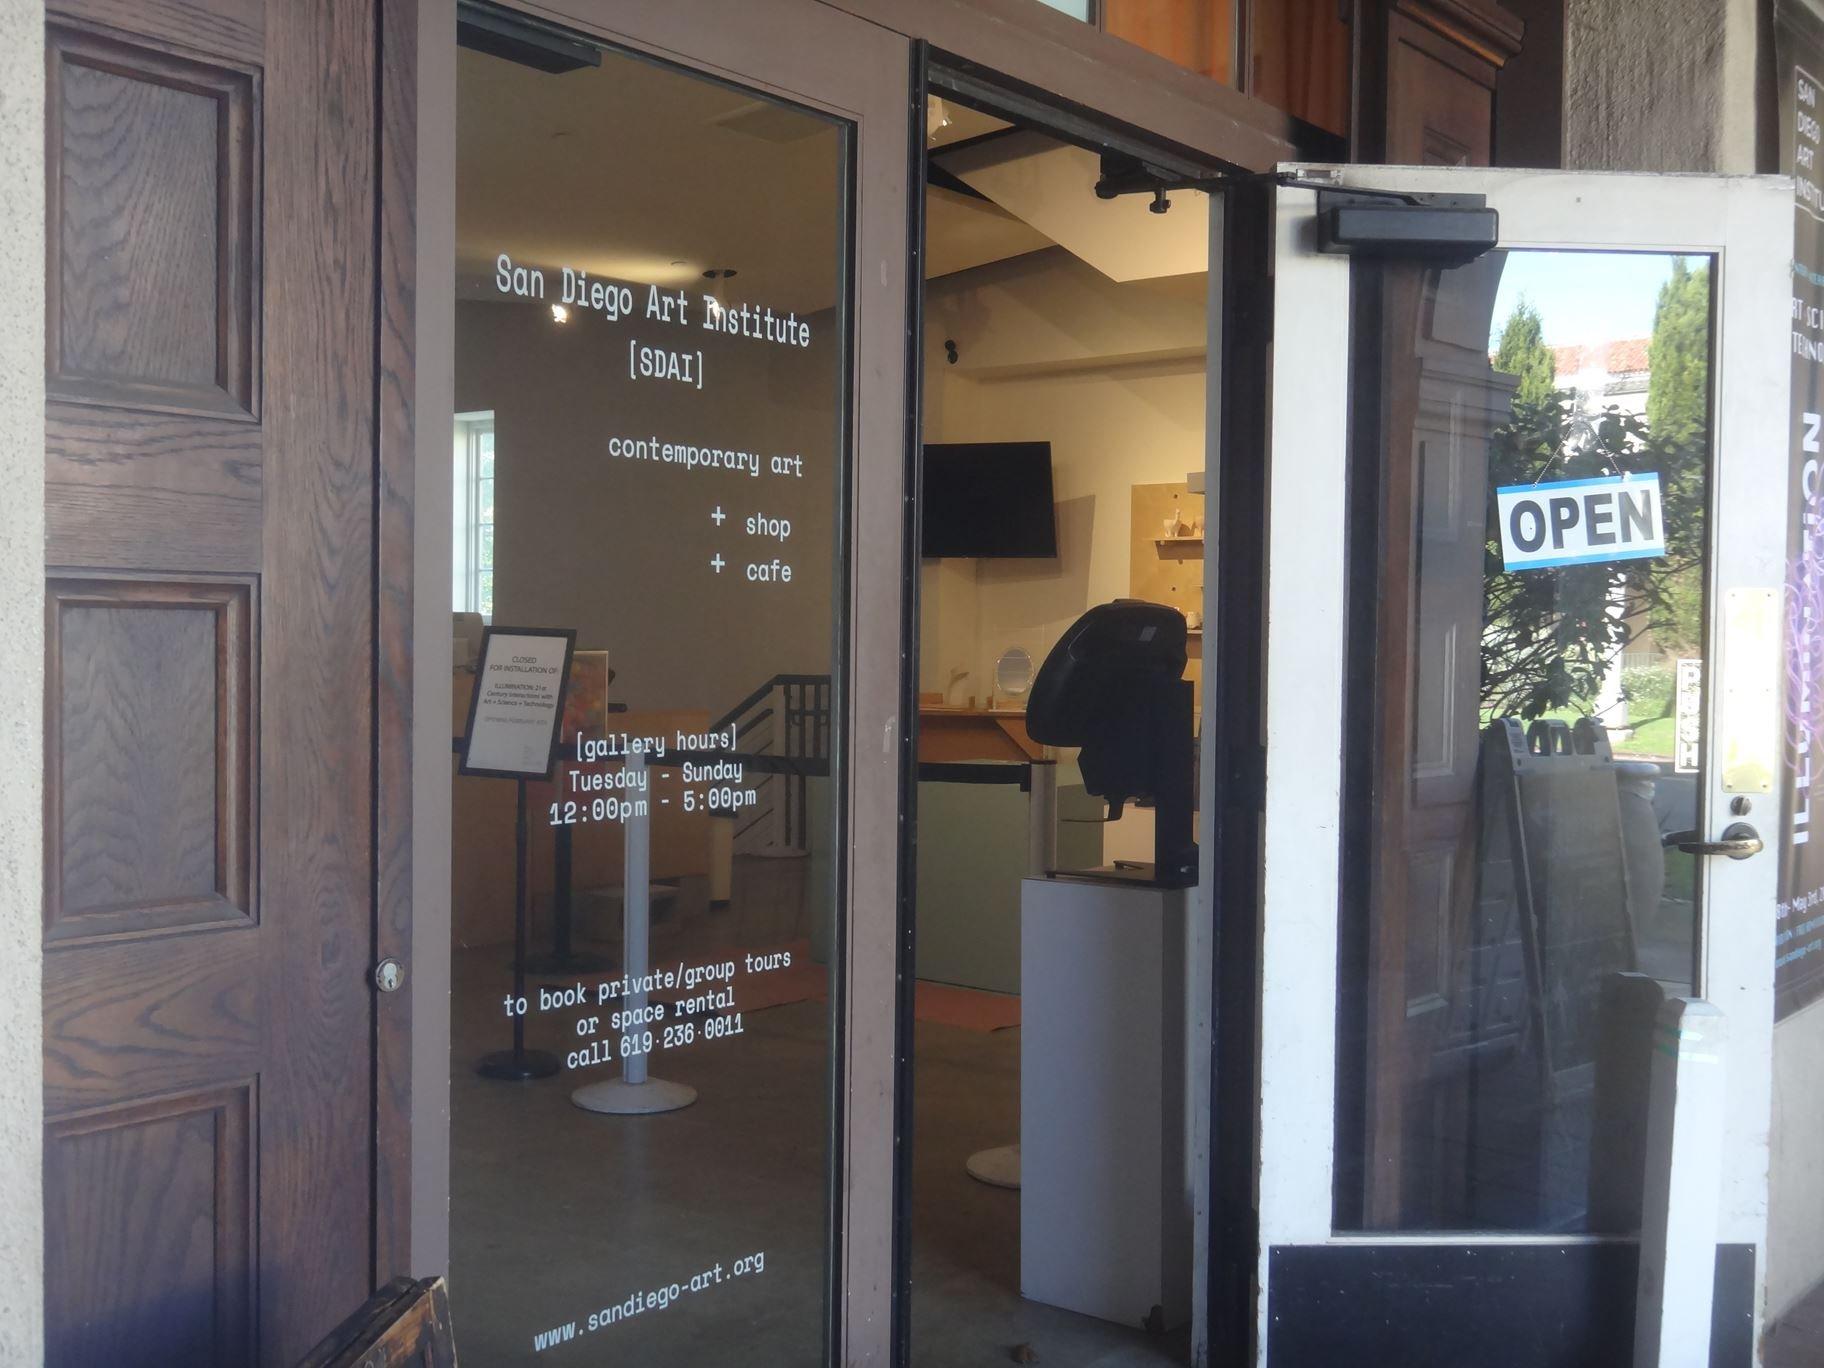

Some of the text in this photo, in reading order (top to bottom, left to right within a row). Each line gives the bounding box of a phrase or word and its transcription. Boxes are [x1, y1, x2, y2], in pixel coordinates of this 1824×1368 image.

[1798, 79, 1816, 108] SAN
[1797, 111, 1821, 145] DIEGO
[1797, 143, 1814, 170] ART
[496, 254, 810, 347] San Diego Art Institute
[629, 340, 703, 389] [SDAI]
[609, 436, 803, 477] contemporary art
[746, 513, 791, 541] shop
[1510, 490, 1654, 553] OPEN
[746, 559, 791, 582] cafe
[1792, 412, 1821, 844] ILLUMITION
[512, 656, 537, 664] CLOSED
[576, 723, 737, 762] [gallery hours]
[569, 767, 648, 792] Tuesday
[683, 759, 743, 786] Sunday
[550, 797, 648, 825] 12:00pm
[684, 787, 757, 811] 5:00pm
[504, 952, 792, 1016] to book private/group tours
[576, 986, 735, 1036] or space rental
[567, 1039, 611, 1070] call
[534, 1251, 764, 1352] www.sandiego-art.org
